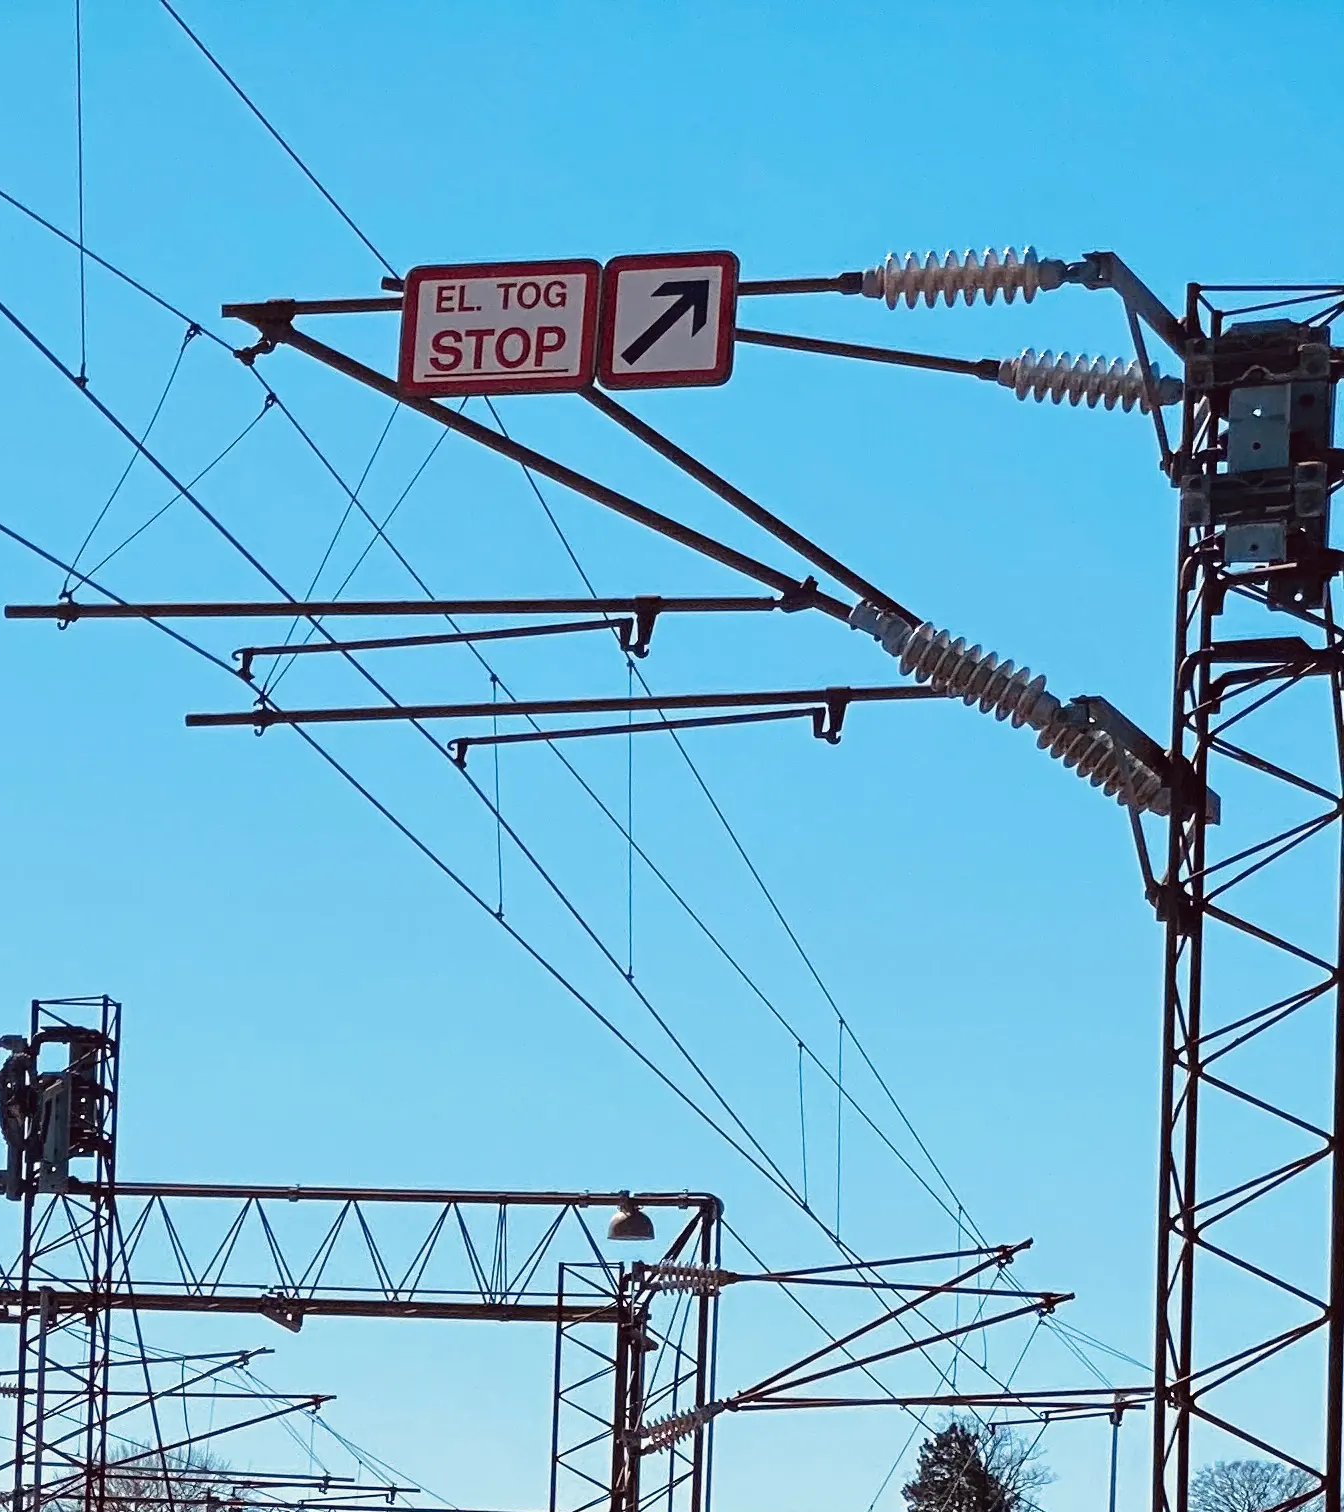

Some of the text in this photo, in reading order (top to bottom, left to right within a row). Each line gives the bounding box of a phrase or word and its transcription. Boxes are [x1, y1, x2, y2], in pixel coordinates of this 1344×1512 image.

[435, 280, 568, 313] EL. TOG
[428, 326, 567, 372] STOP
